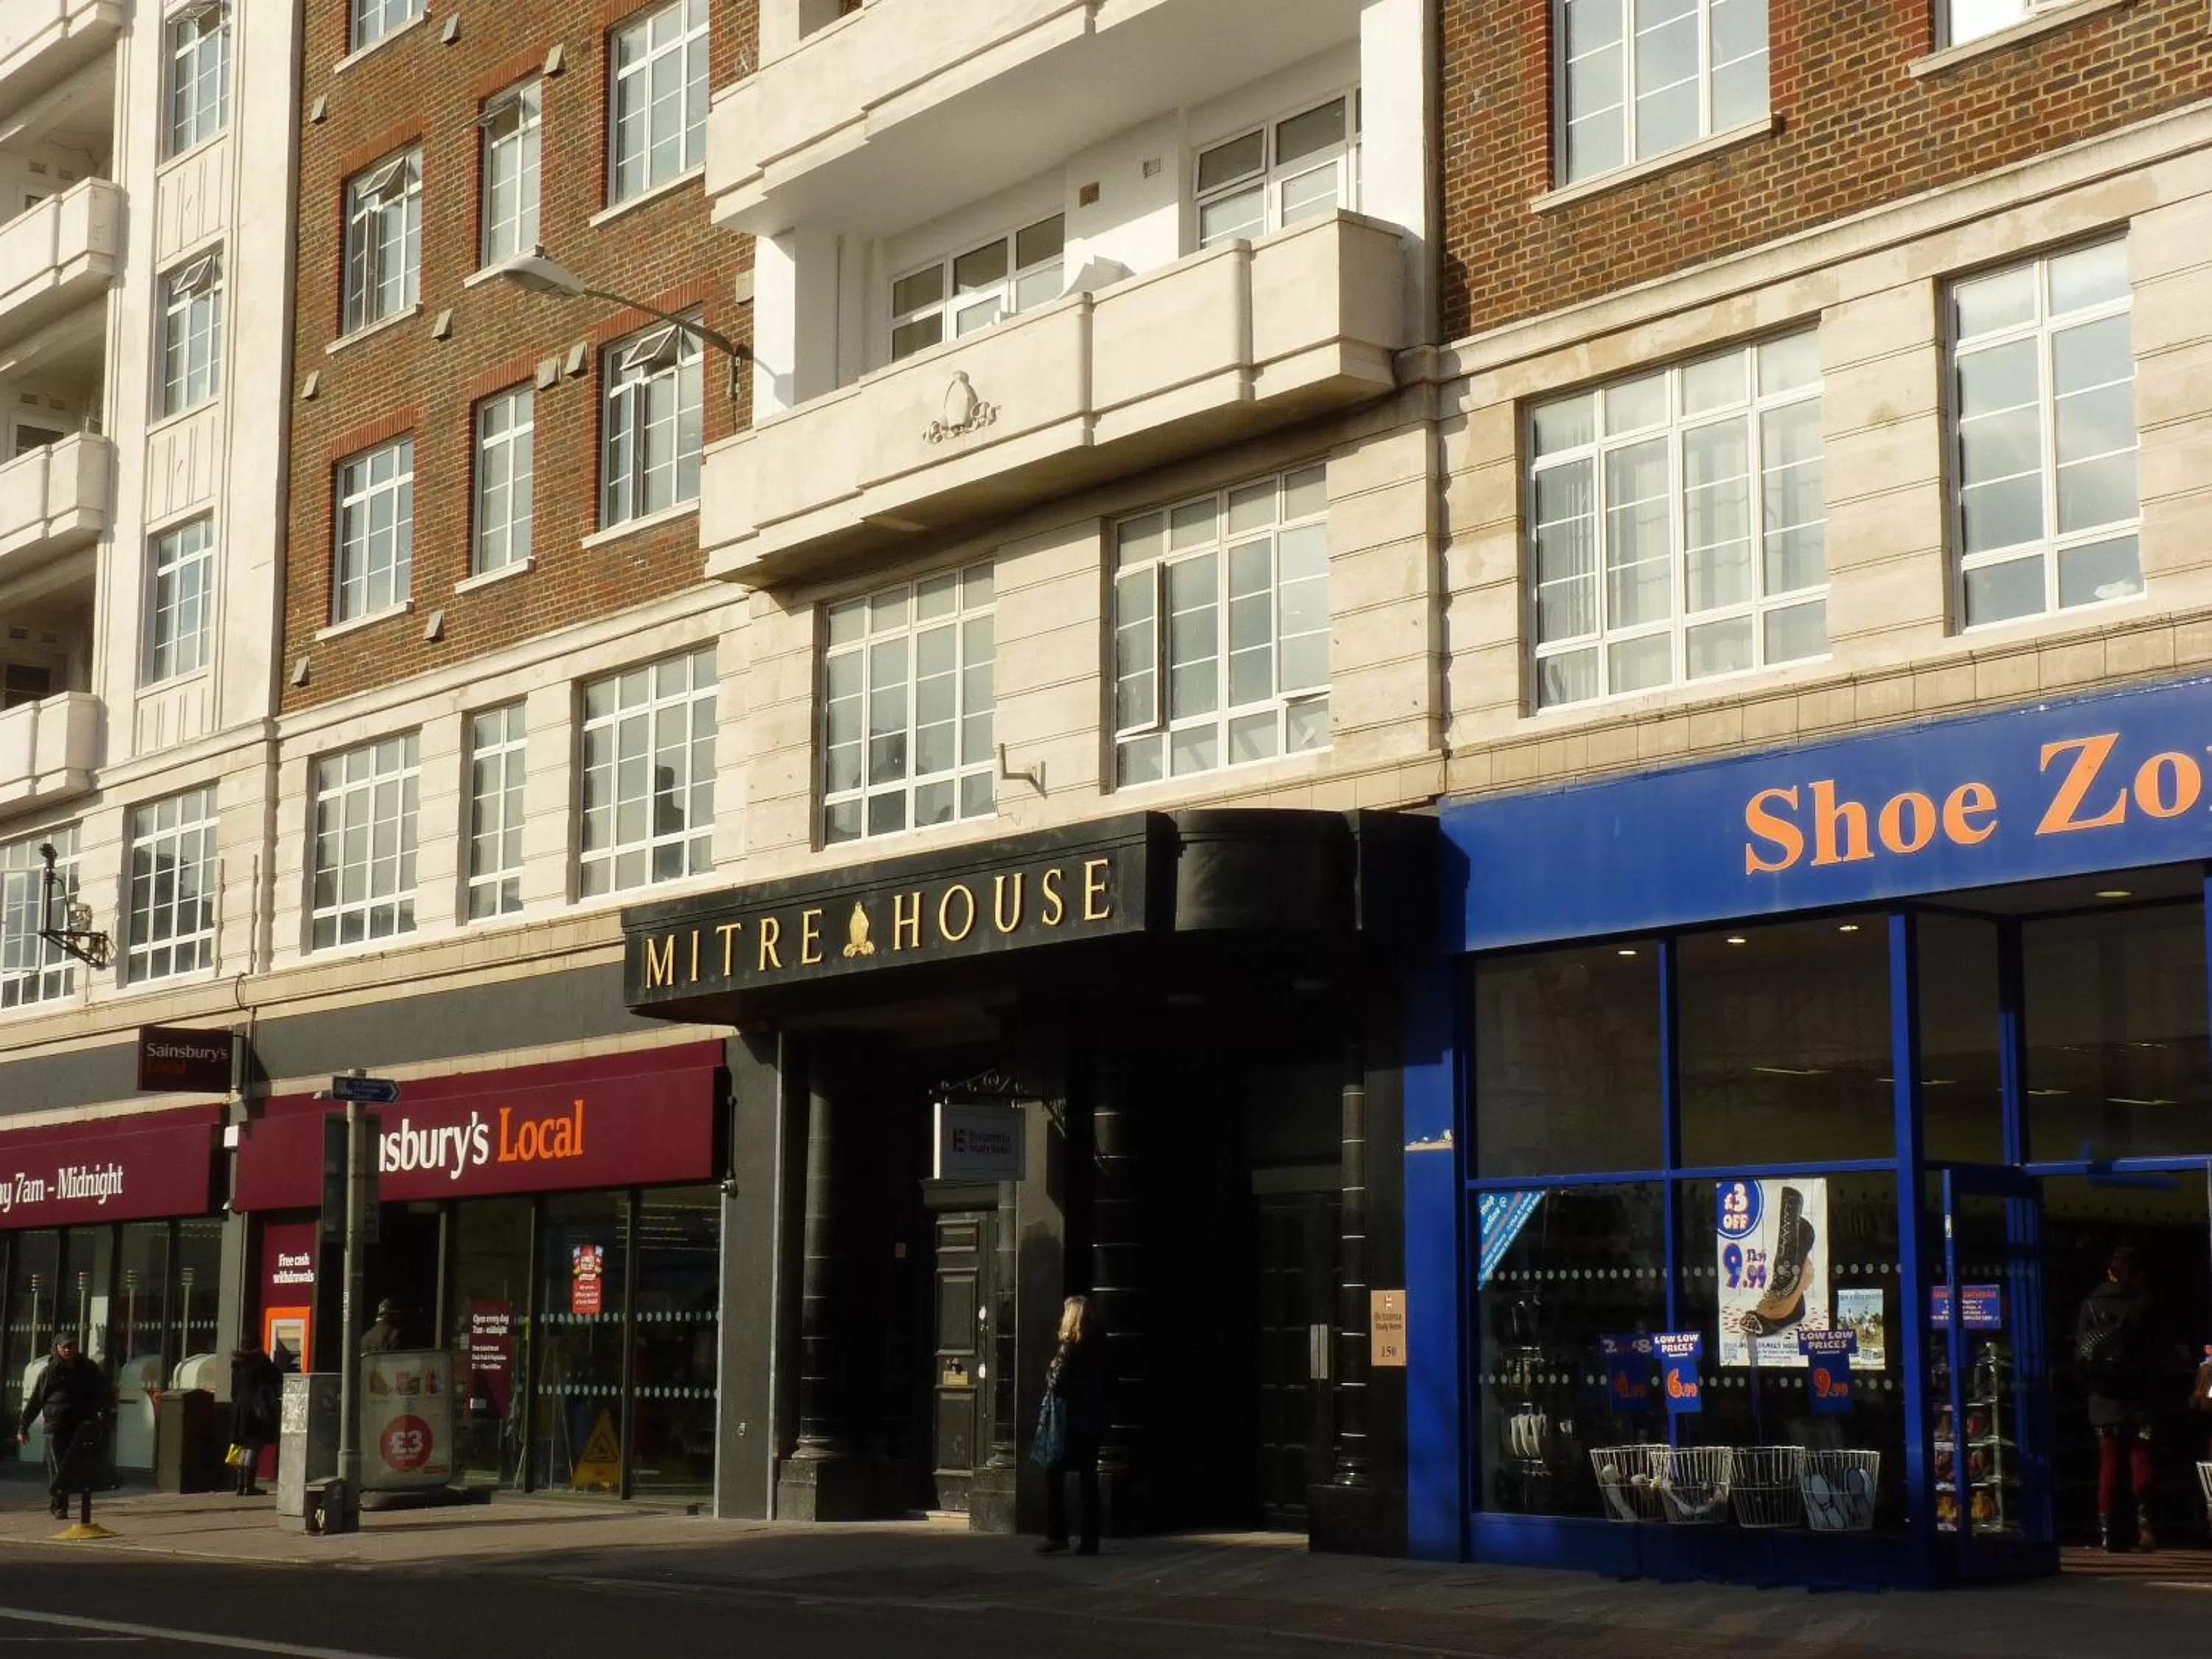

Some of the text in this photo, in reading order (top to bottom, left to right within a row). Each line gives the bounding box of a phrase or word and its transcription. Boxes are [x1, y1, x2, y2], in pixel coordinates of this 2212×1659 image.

[1745, 731, 2212, 876] Shoe Zo
[646, 858, 1110, 989] MITRE HOUSE
[147, 1042, 229, 1063] Sainsbury's
[498, 1099, 585, 1162] Local
[15, 1172, 44, 1203] 7am
[56, 1163, 123, 1206] Midnight
[1724, 1183, 1748, 1212] £3
[1723, 1213, 1749, 1230] OFF
[278, 1252, 310, 1267] Free cash
[473, 1313, 486, 1325] Open
[1654, 1333, 1700, 1344] LOW LOW
[1800, 1330, 1854, 1340] LOW LOW
[1381, 1345, 1397, 1357] 150
[1661, 1343, 1694, 1353] PRICES
[1808, 1340, 1848, 1349] PRICES
[390, 1430, 425, 1455] £3
